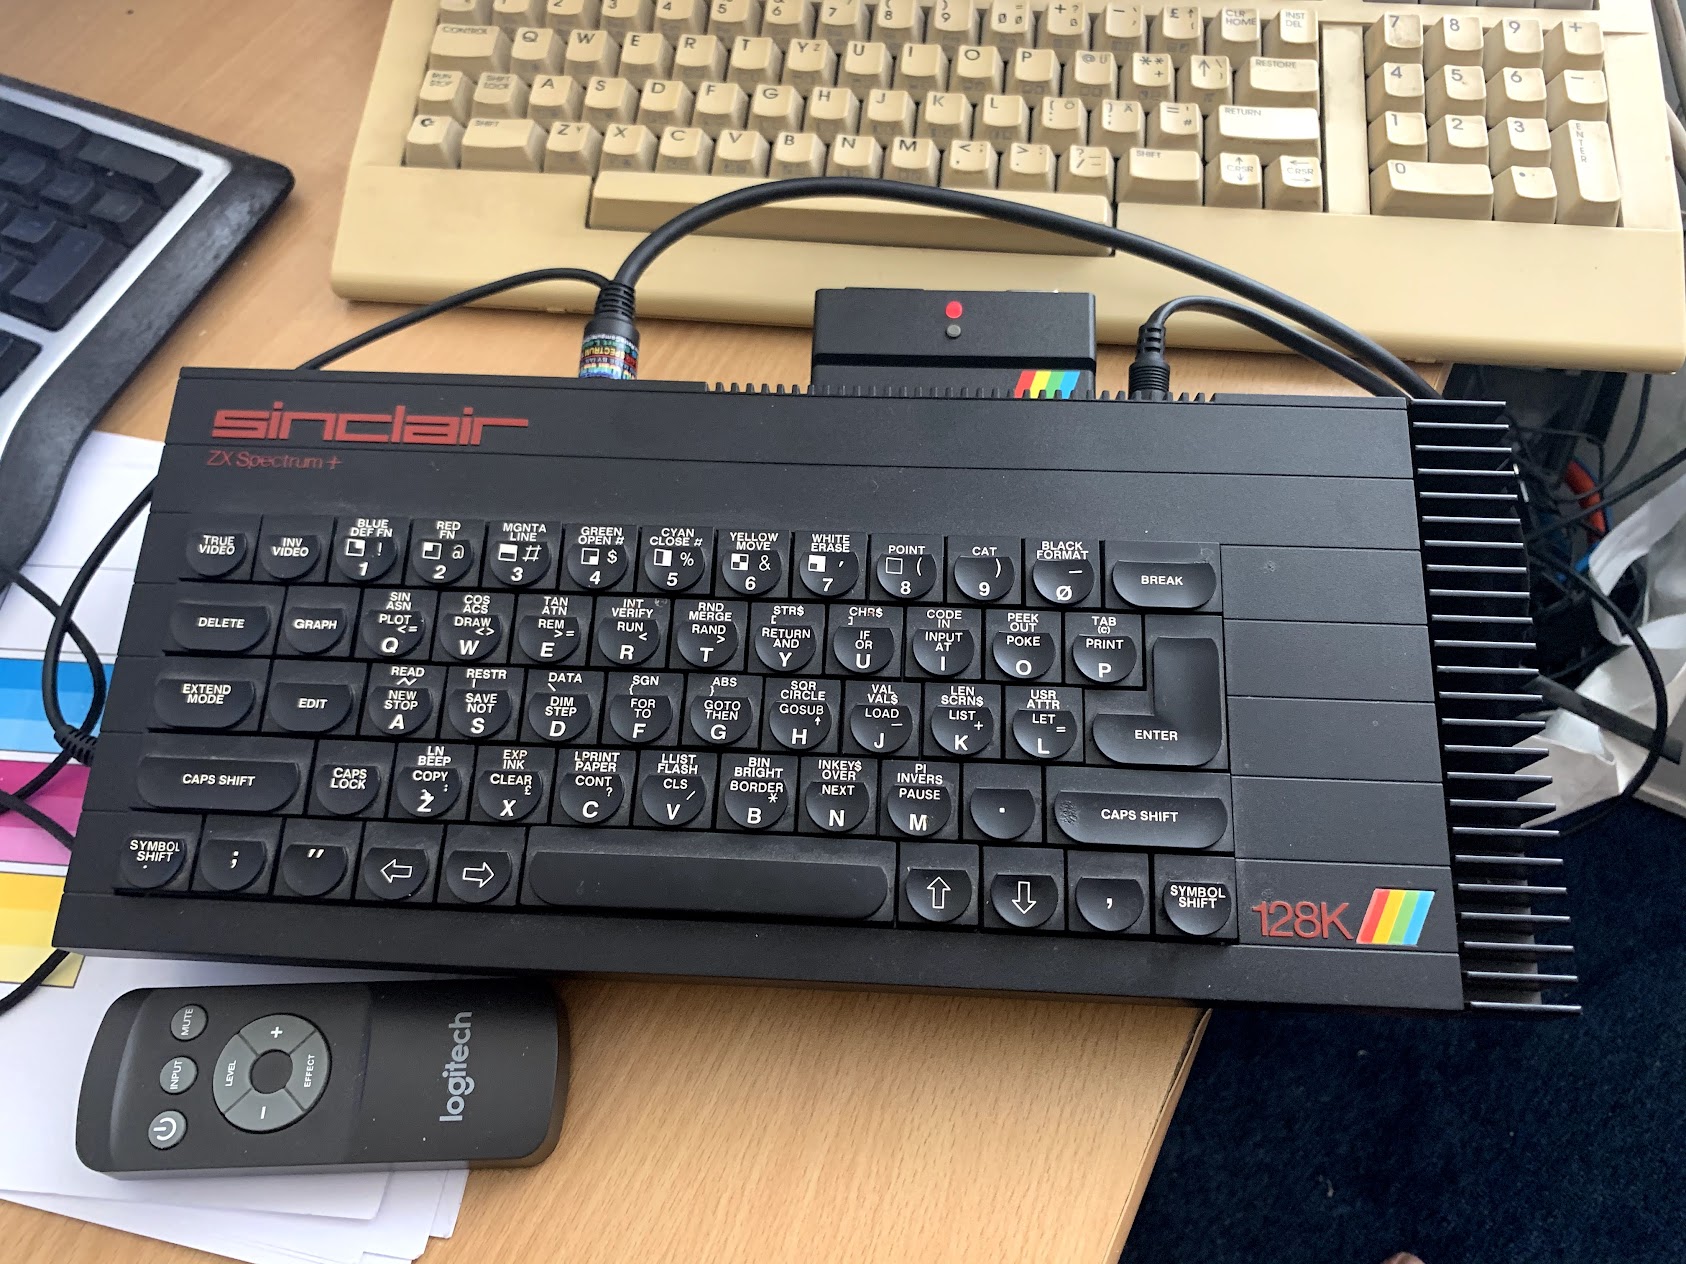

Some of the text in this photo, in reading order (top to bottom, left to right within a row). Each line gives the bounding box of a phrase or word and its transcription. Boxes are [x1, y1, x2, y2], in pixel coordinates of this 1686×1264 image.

[1389, 16, 1400, 28] 7
[1449, 18, 1460, 31] 8
[1508, 21, 1520, 34] 9
[1391, 67, 1402, 78] 4
[1451, 69, 1463, 81] 5
[1511, 71, 1523, 83] 6
[1391, 114, 1398, 126] 1
[1451, 118, 1464, 130] 2
[1514, 121, 1525, 132] 3
[1395, 163, 1406, 174] 0
[211, 401, 529, 446] sinclair
[207, 451, 231, 467] ZX
[236, 452, 323, 470] Spectrum
[357, 519, 388, 529] BLUE
[437, 521, 461, 530] RED
[503, 523, 547, 533] MGNTA
[350, 527, 393, 538] DEF FN
[439, 530, 456, 539] FN
[510, 532, 537, 541] LINE
[581, 527, 622, 536] GREEN
[661, 528, 694, 537] CYAN
[730, 532, 779, 542] YELLOW
[204, 536, 234, 546] TRUE
[282, 538, 303, 547] INV
[578, 535, 611, 545] OPEN
[649, 536, 690, 546] CLOSE
[811, 534, 850, 544] WHITE
[200, 544, 235, 555] VIDEO
[736, 541, 771, 550] MOVE
[811, 543, 850, 553] ERASE
[888, 545, 925, 555] POINT
[972, 546, 997, 556] CAT
[1042, 541, 1083, 551] BLACK
[273, 546, 309, 557] VIDEO
[1036, 550, 1088, 560] FORMAT
[1141, 576, 1183, 585] BREAK
[390, 592, 411, 601] SIN
[464, 595, 490, 605] COS
[544, 597, 568, 606] TAN
[386, 601, 412, 610] ASN
[463, 604, 489, 614] ACS
[623, 599, 643, 608] INT
[698, 602, 724, 612] RND
[541, 606, 567, 615] ATN
[611, 608, 653, 618] VERIFY
[688, 611, 732, 621] MERGE
[773, 605, 804, 616] STR$
[849, 607, 883, 618] CHR$
[926, 610, 962, 620] CODE
[198, 617, 245, 628] DELETE
[379, 614, 411, 625] PLOT
[454, 617, 491, 627] DRAW
[938, 619, 951, 628] IN
[1008, 613, 1039, 623] PEEK
[1092, 617, 1117, 626] TAB
[294, 619, 337, 629] GRAPH
[538, 619, 565, 629] REM
[617, 621, 643, 632] RUN
[691, 624, 726, 634] RAND
[1010, 622, 1037, 632] OUT
[762, 628, 810, 639] RETURN
[859, 631, 870, 640] IF
[925, 632, 963, 642] INPUT
[773, 638, 800, 648] AND
[855, 639, 873, 650] OR
[935, 642, 951, 652] AT
[1007, 636, 1041, 647] POKE
[1086, 639, 1123, 649] PRINT
[391, 666, 424, 677] READ
[466, 669, 507, 679] RESTR
[548, 673, 583, 683] DATA
[632, 675, 659, 686] SGN
[712, 677, 737, 687] ABS
[183, 684, 231, 695] EXTEND
[790, 681, 816, 691] SQR
[871, 684, 896, 695] VAL
[950, 686, 975, 696] LEN
[187, 694, 224, 705] MODE
[388, 690, 417, 700] NEW
[465, 693, 497, 703] SAVE
[780, 690, 826, 701] CIRCLE
[867, 694, 898, 705] VAL$
[1030, 689, 1056, 699] USR
[298, 698, 328, 709] EDIT
[384, 700, 418, 711] STOP
[550, 696, 574, 706] DIM
[630, 699, 656, 708] FOR
[704, 700, 741, 711] GOTO
[941, 696, 984, 707] SCRN$
[1026, 699, 1060, 710] ATTR
[467, 703, 494, 713] NOT
[545, 706, 577, 717] STEP
[634, 708, 652, 718] TO
[780, 705, 824, 715] GOSUB
[865, 708, 900, 719] LOAD
[705, 710, 739, 720] THEN
[949, 710, 976, 721] LIST
[1032, 714, 1055, 724] LET
[1134, 730, 1178, 741] ENTER
[427, 746, 445, 756] LN
[503, 750, 528, 760] EXP
[418, 755, 451, 766] BEEP
[575, 752, 620, 763] LPRINT
[662, 754, 696, 764] LLIST
[748, 758, 770, 767] BIN
[503, 760, 525, 769] INK
[575, 761, 617, 772] PAPER
[657, 763, 698, 774] FLASH
[818, 760, 862, 771] INKEY$
[915, 764, 926, 773] PI
[333, 768, 367, 779] CAPS
[412, 770, 448, 782] COPY
[734, 767, 783, 778] BRIGHT
[821, 770, 856, 781] OVER
[182, 774, 255, 786] CAPS SHIFT
[331, 778, 366, 790] LOCK
[490, 774, 532, 786] CLEAR
[575, 776, 612, 787] CONT
[663, 779, 688, 789] CLS
[897, 773, 943, 785] INVERS
[730, 781, 784, 793] BORDER
[821, 785, 855, 796] NEXT
[899, 788, 941, 800] PAUSE
[1101, 809, 1178, 822] CAPS SHIFT
[130, 840, 180, 852] SYMBOL
[136, 850, 173, 862] SHIFT
[1170, 886, 1226, 898] SYMBOL
[1178, 897, 1217, 909] SHIFT
[1252, 901, 1354, 940] 128K
[181, 1008, 193, 1036] MUTE
[304, 1054, 314, 1087] EFFECT
[439, 1011, 475, 1122] logitech
[170, 1060, 183, 1090] INPUT
[225, 1060, 237, 1087] LEVEL
